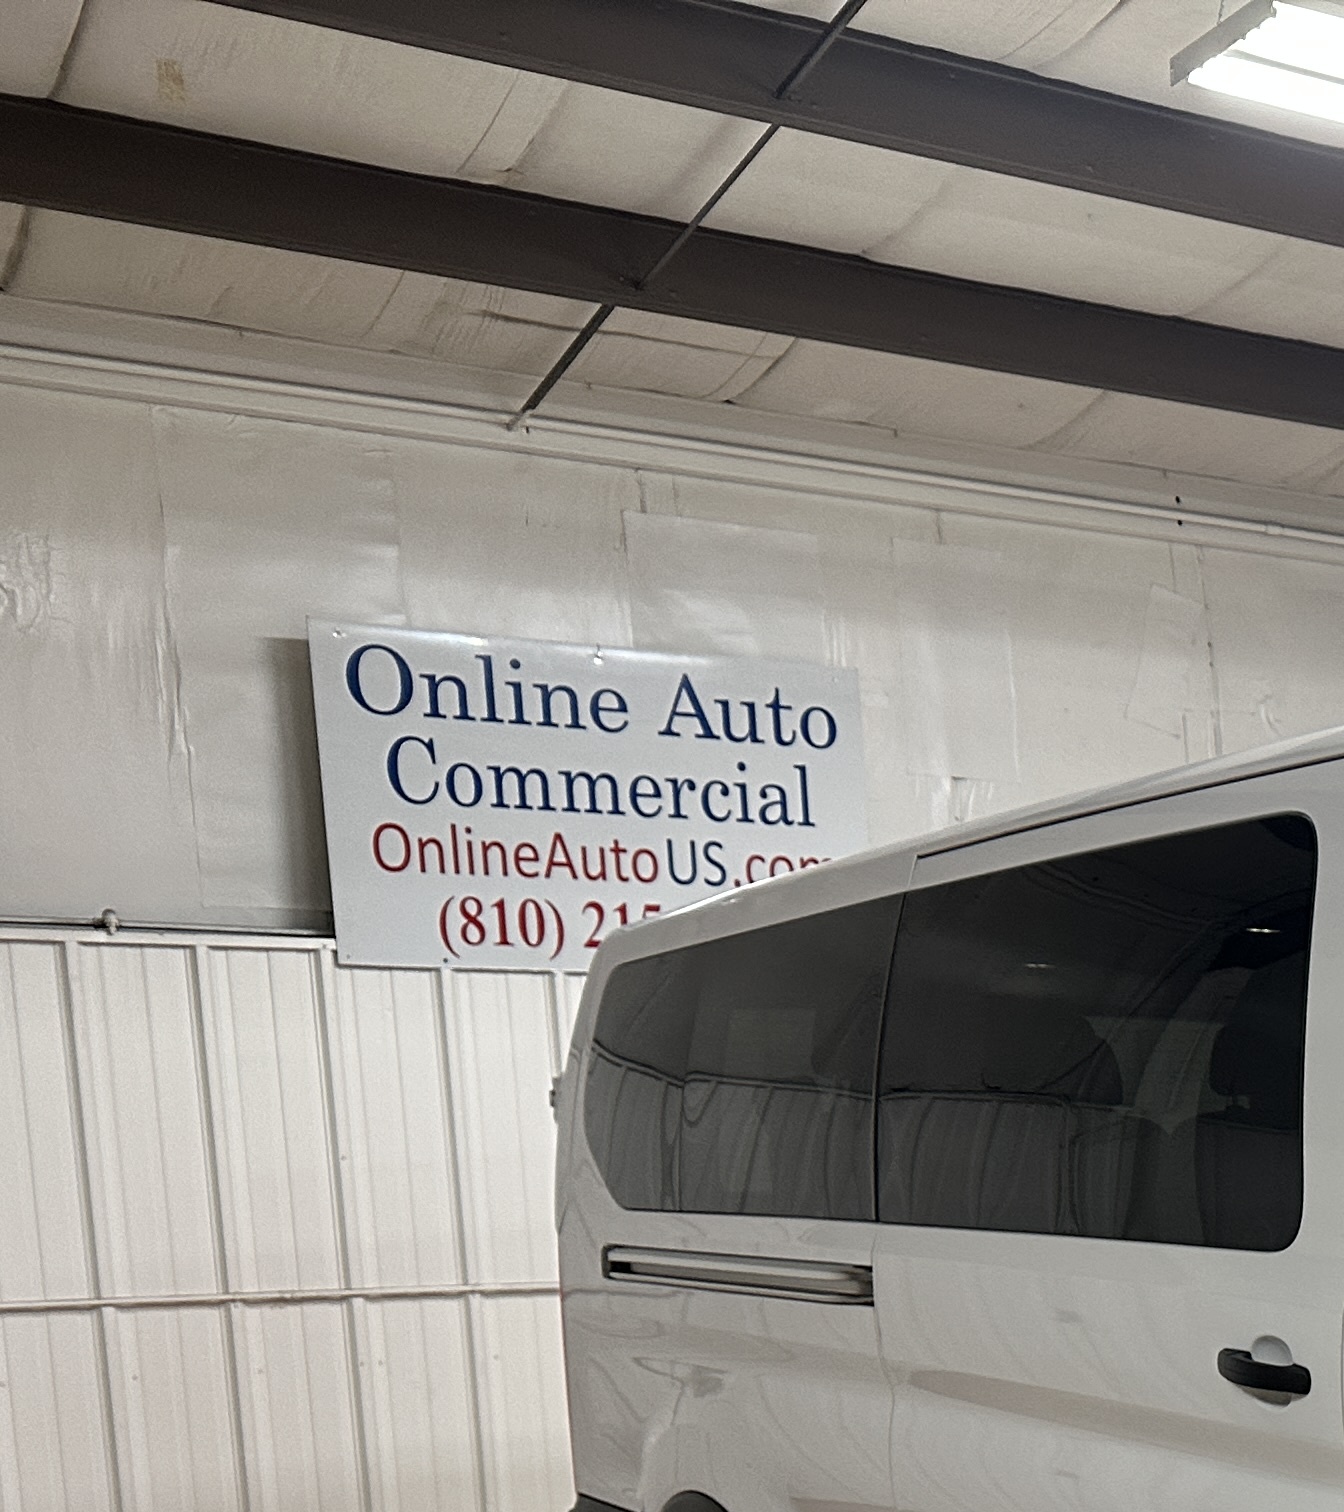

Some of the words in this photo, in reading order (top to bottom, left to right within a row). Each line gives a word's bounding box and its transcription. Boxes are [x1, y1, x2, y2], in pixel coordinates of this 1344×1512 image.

[345, 643, 629, 733] Online
[658, 673, 838, 750] Auto
[386, 735, 817, 828] Commercial
[371, 821, 832, 890] OnlineAutoUS.co
[438, 895, 565, 961] (810)
[582, 900, 661, 949] 21
